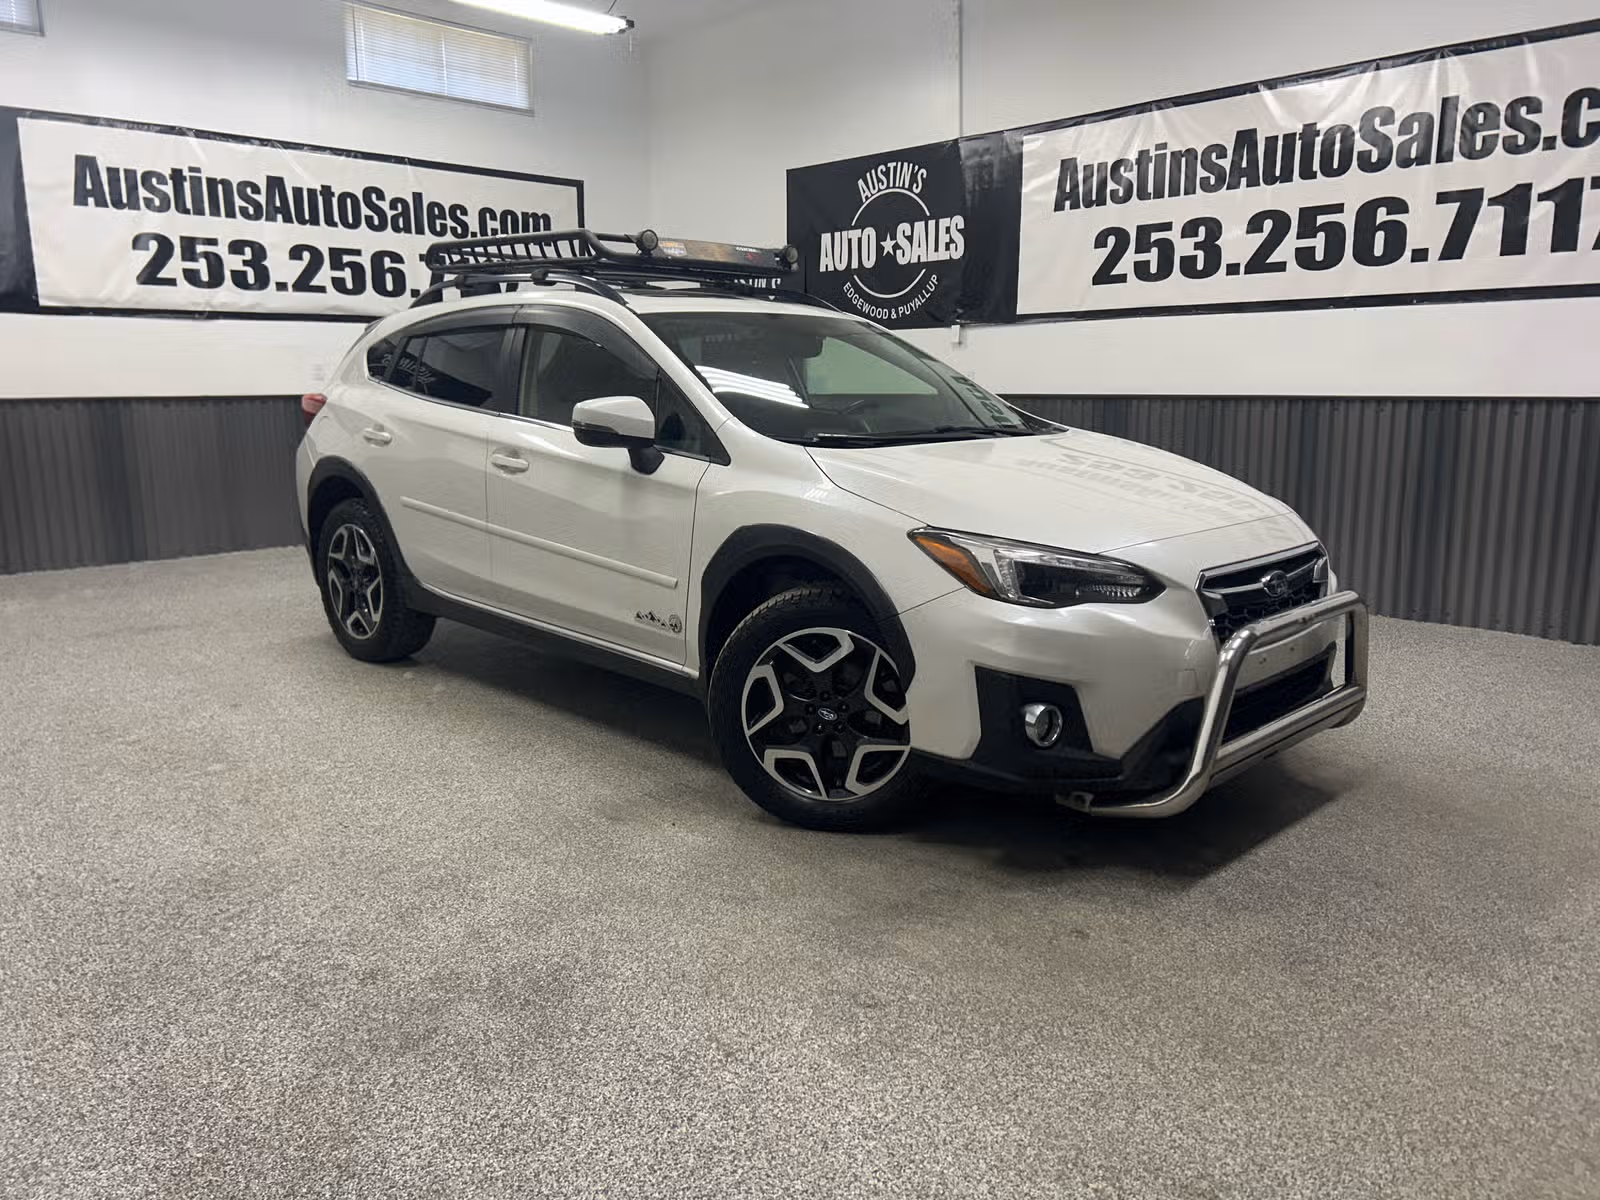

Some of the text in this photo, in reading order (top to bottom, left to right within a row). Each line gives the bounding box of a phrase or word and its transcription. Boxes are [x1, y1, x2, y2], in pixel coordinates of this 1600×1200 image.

[73, 153, 552, 241] AustinsAutoSales.com
[857, 161, 927, 203] AUSTIN'S
[819, 214, 965, 273] AUTO SALES
[1092, 176, 1600, 286] 253.256.711
[131, 231, 519, 300] 253.256.
[842, 274, 939, 320] EDGEWOOD & PUYALLUP
